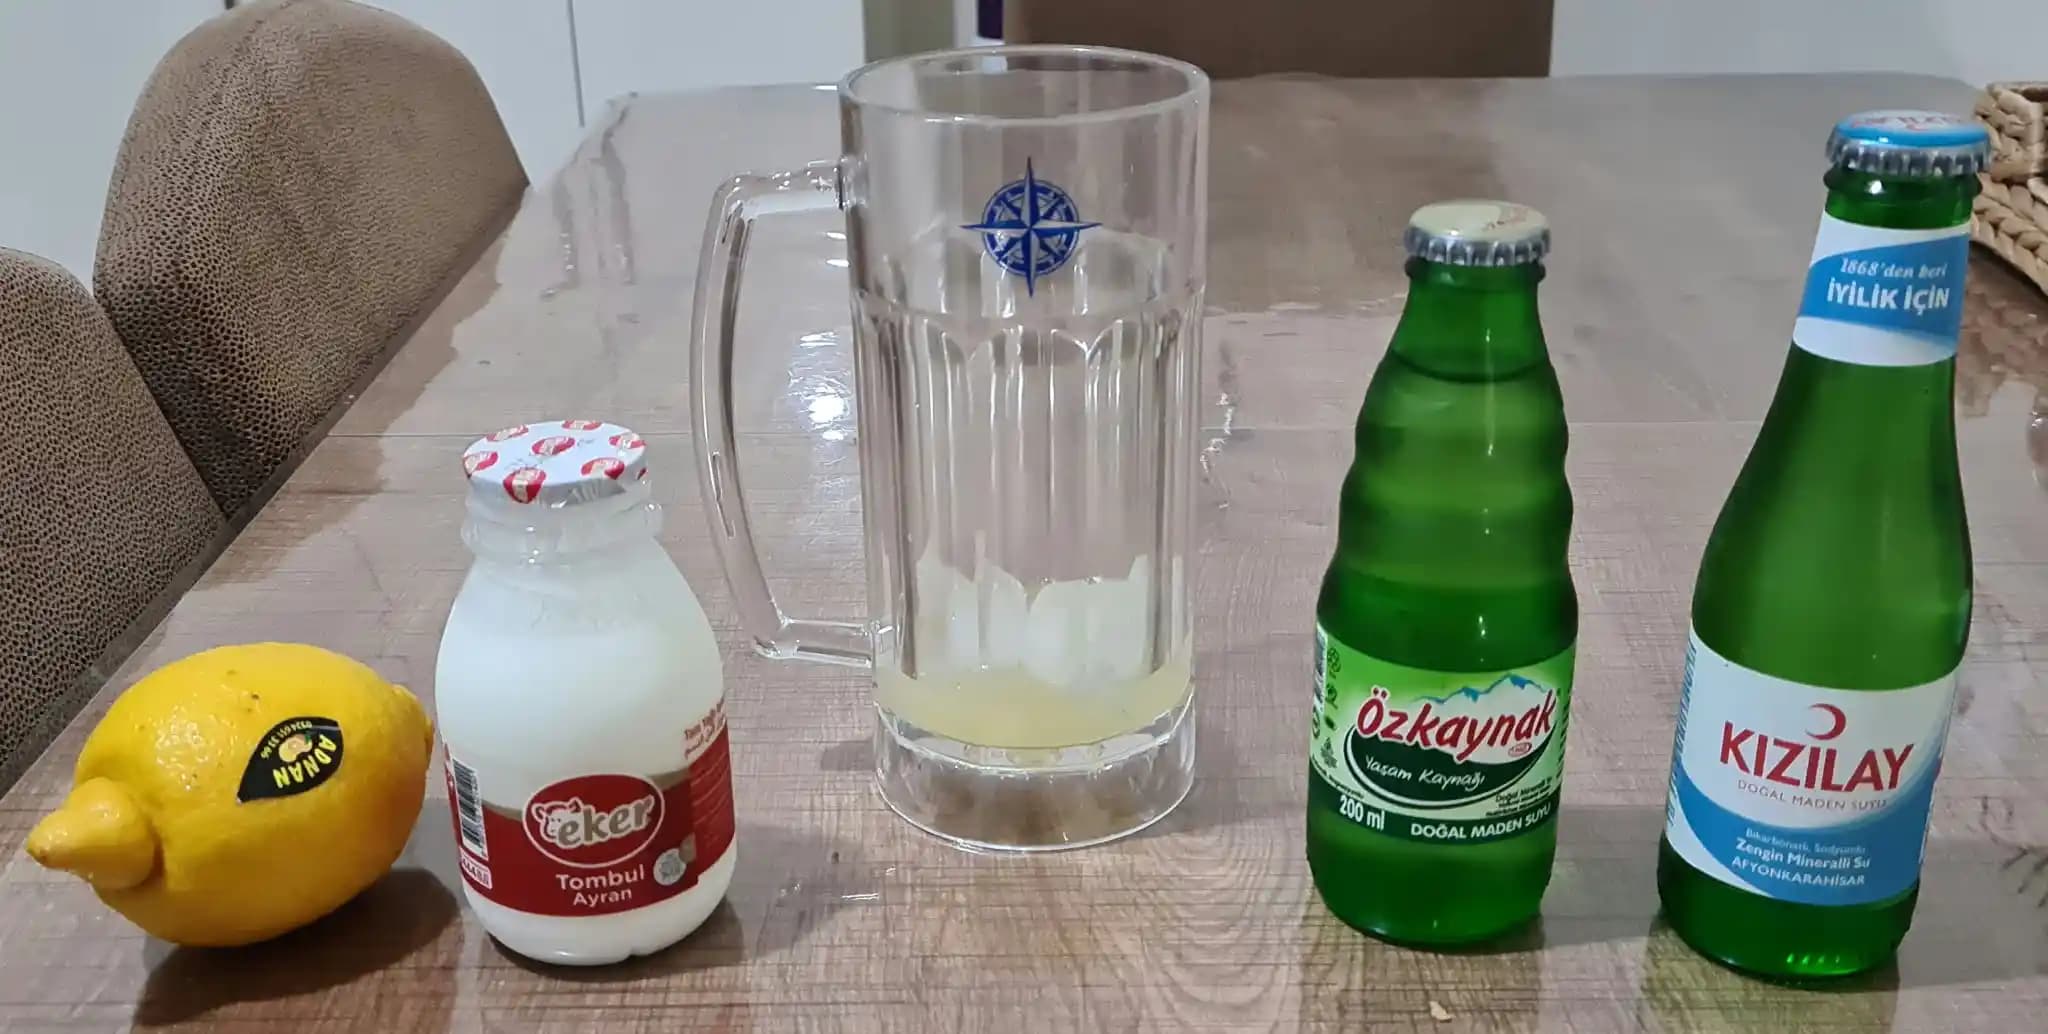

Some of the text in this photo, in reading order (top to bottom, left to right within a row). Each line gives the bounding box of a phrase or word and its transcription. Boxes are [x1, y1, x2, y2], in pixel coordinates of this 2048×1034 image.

[1827, 277, 1950, 315] İYİLİK İÇİN
[1356, 687, 1555, 761] Özkaynak
[272, 733, 337, 789] ADNAN
[1719, 720, 1914, 793] KIZILAY
[556, 794, 654, 848] eker
[1339, 795, 1386, 831] 200 ml
[1470, 819, 1522, 839] MADEN
[1524, 803, 1551, 828] SUYU
[1791, 795, 1846, 811] MADEN
[1735, 838, 1870, 870] Zengin Mineralli Su
[555, 864, 646, 890] Tombul
[572, 888, 633, 908] Ayran
